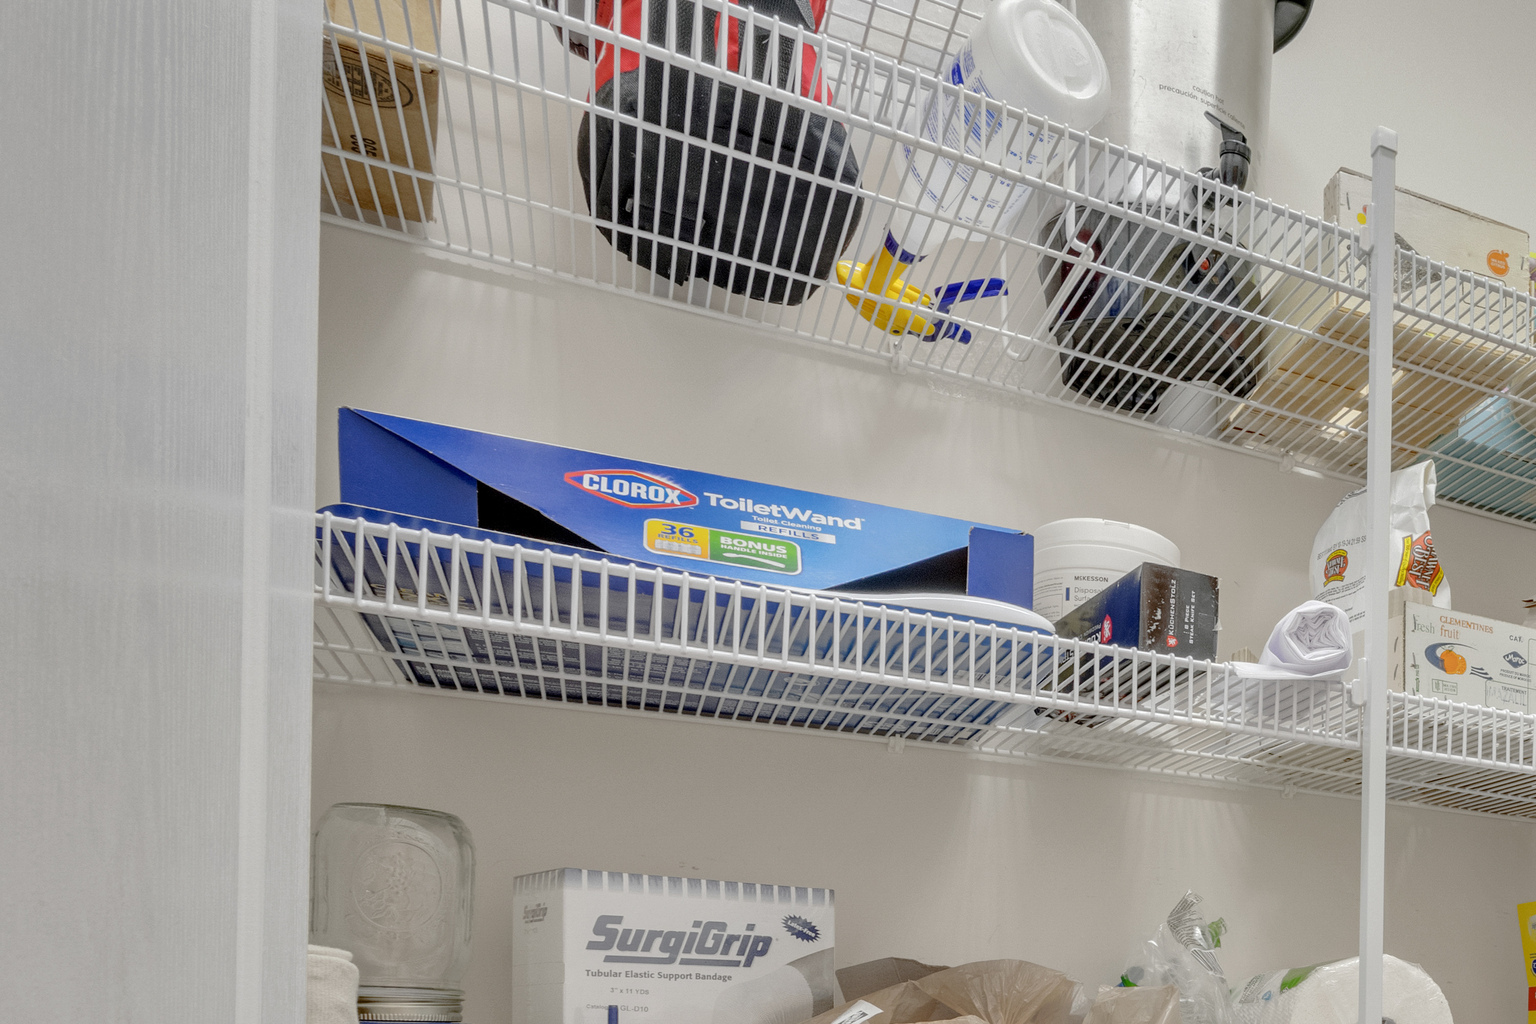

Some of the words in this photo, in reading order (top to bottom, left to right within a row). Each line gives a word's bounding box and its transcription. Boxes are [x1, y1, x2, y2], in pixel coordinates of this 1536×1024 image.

[582, 473, 681, 505] CLOROX
[703, 492, 862, 531] ToiletWand
[661, 523, 694, 539] 36
[757, 524, 820, 541] REFILLS
[780, 519, 822, 533] Cleaning
[657, 533, 699, 544] REFILLS
[720, 536, 787, 555] BONUS
[720, 544, 750, 556] HANDLE
[1440, 615, 1494, 634] CLEMENTINES
[1440, 625, 1459, 640] fruit
[586, 914, 773, 967] SurgiGrip
[586, 969, 622, 979] Tubular
[625, 970, 655, 979] Elastic
[657, 972, 693, 982] Support
[695, 972, 733, 983] Bandage
